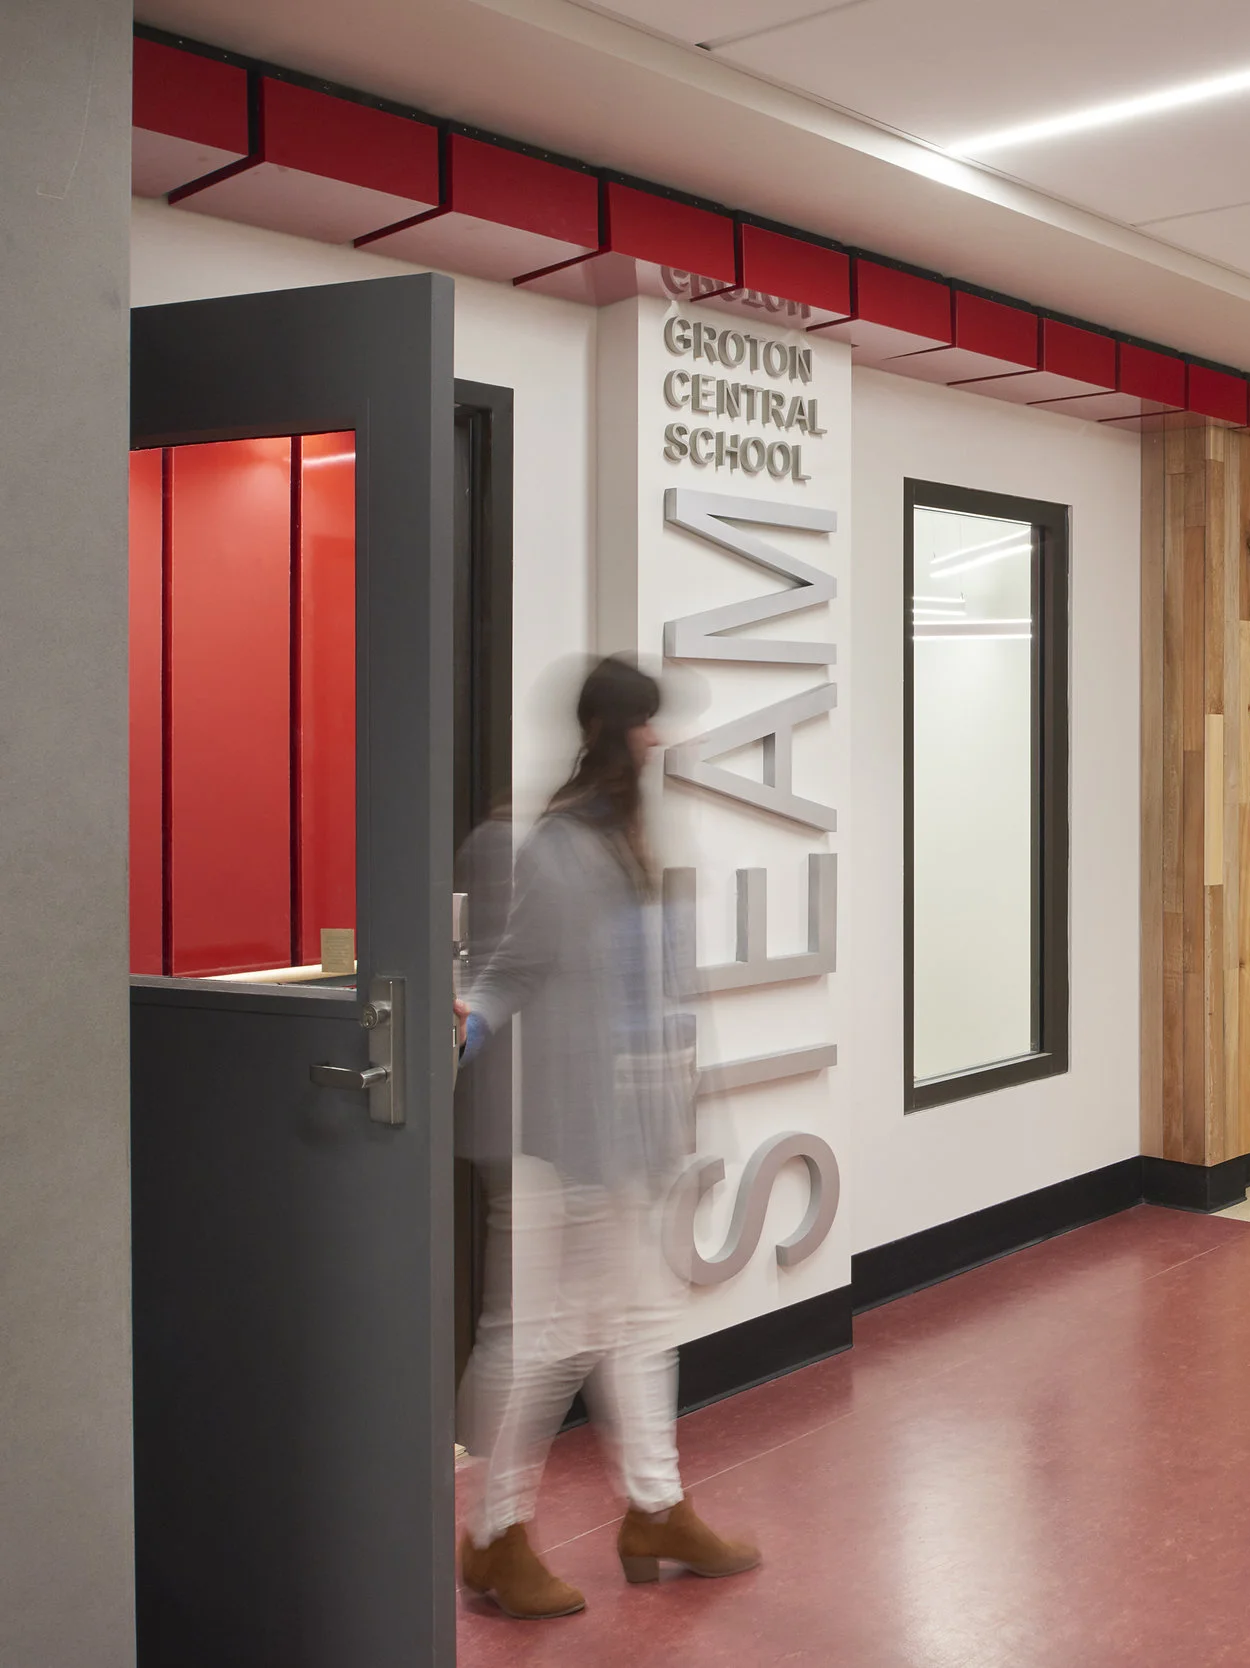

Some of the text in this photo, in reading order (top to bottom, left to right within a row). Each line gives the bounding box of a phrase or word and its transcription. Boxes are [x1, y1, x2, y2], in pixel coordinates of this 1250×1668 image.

[663, 315, 813, 384] GROTON
[663, 369, 828, 435] CENTRAL
[663, 422, 812, 481] SCHOOL
[662, 487, 841, 1287] STEAM
